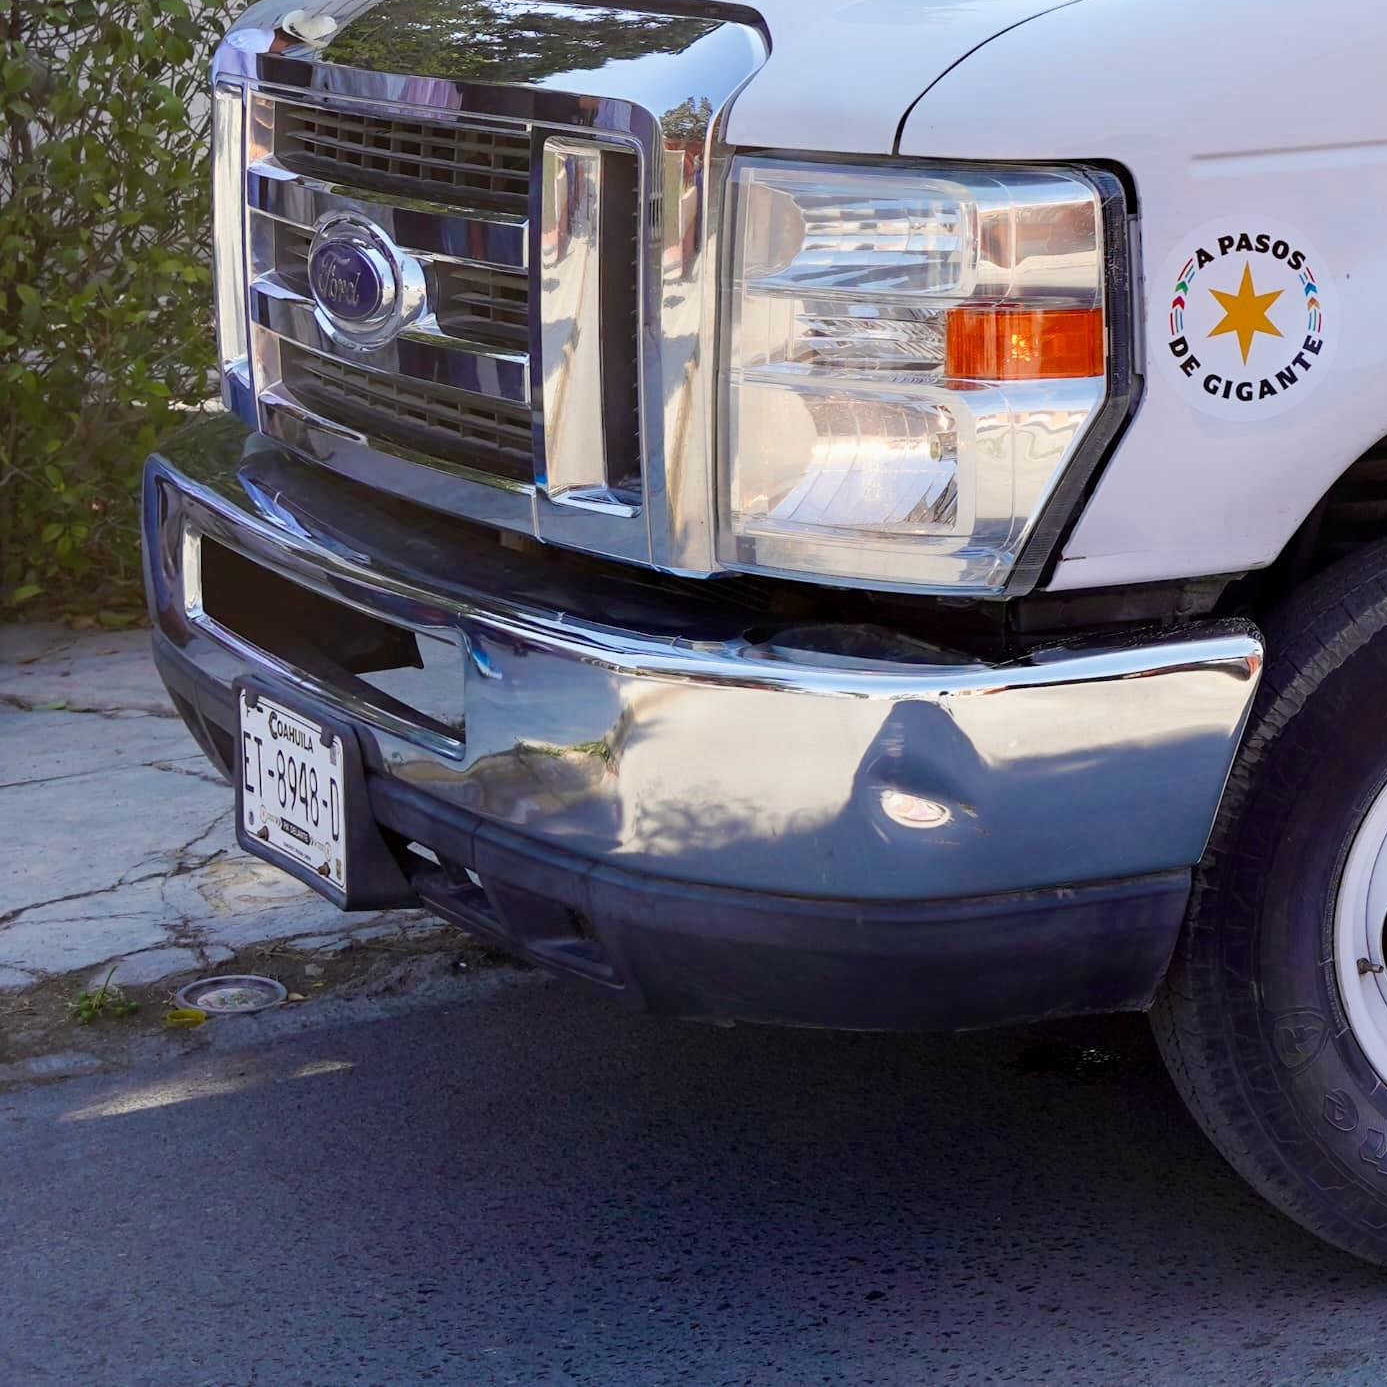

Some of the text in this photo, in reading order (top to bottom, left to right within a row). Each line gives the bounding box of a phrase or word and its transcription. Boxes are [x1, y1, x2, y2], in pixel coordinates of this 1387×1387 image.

[319, 251, 361, 306] Ford
[1195, 233, 1306, 270] A PASOS
[1168, 334, 1324, 402] DE GIGANTE
[243, 730, 340, 842] ET-8948-D
